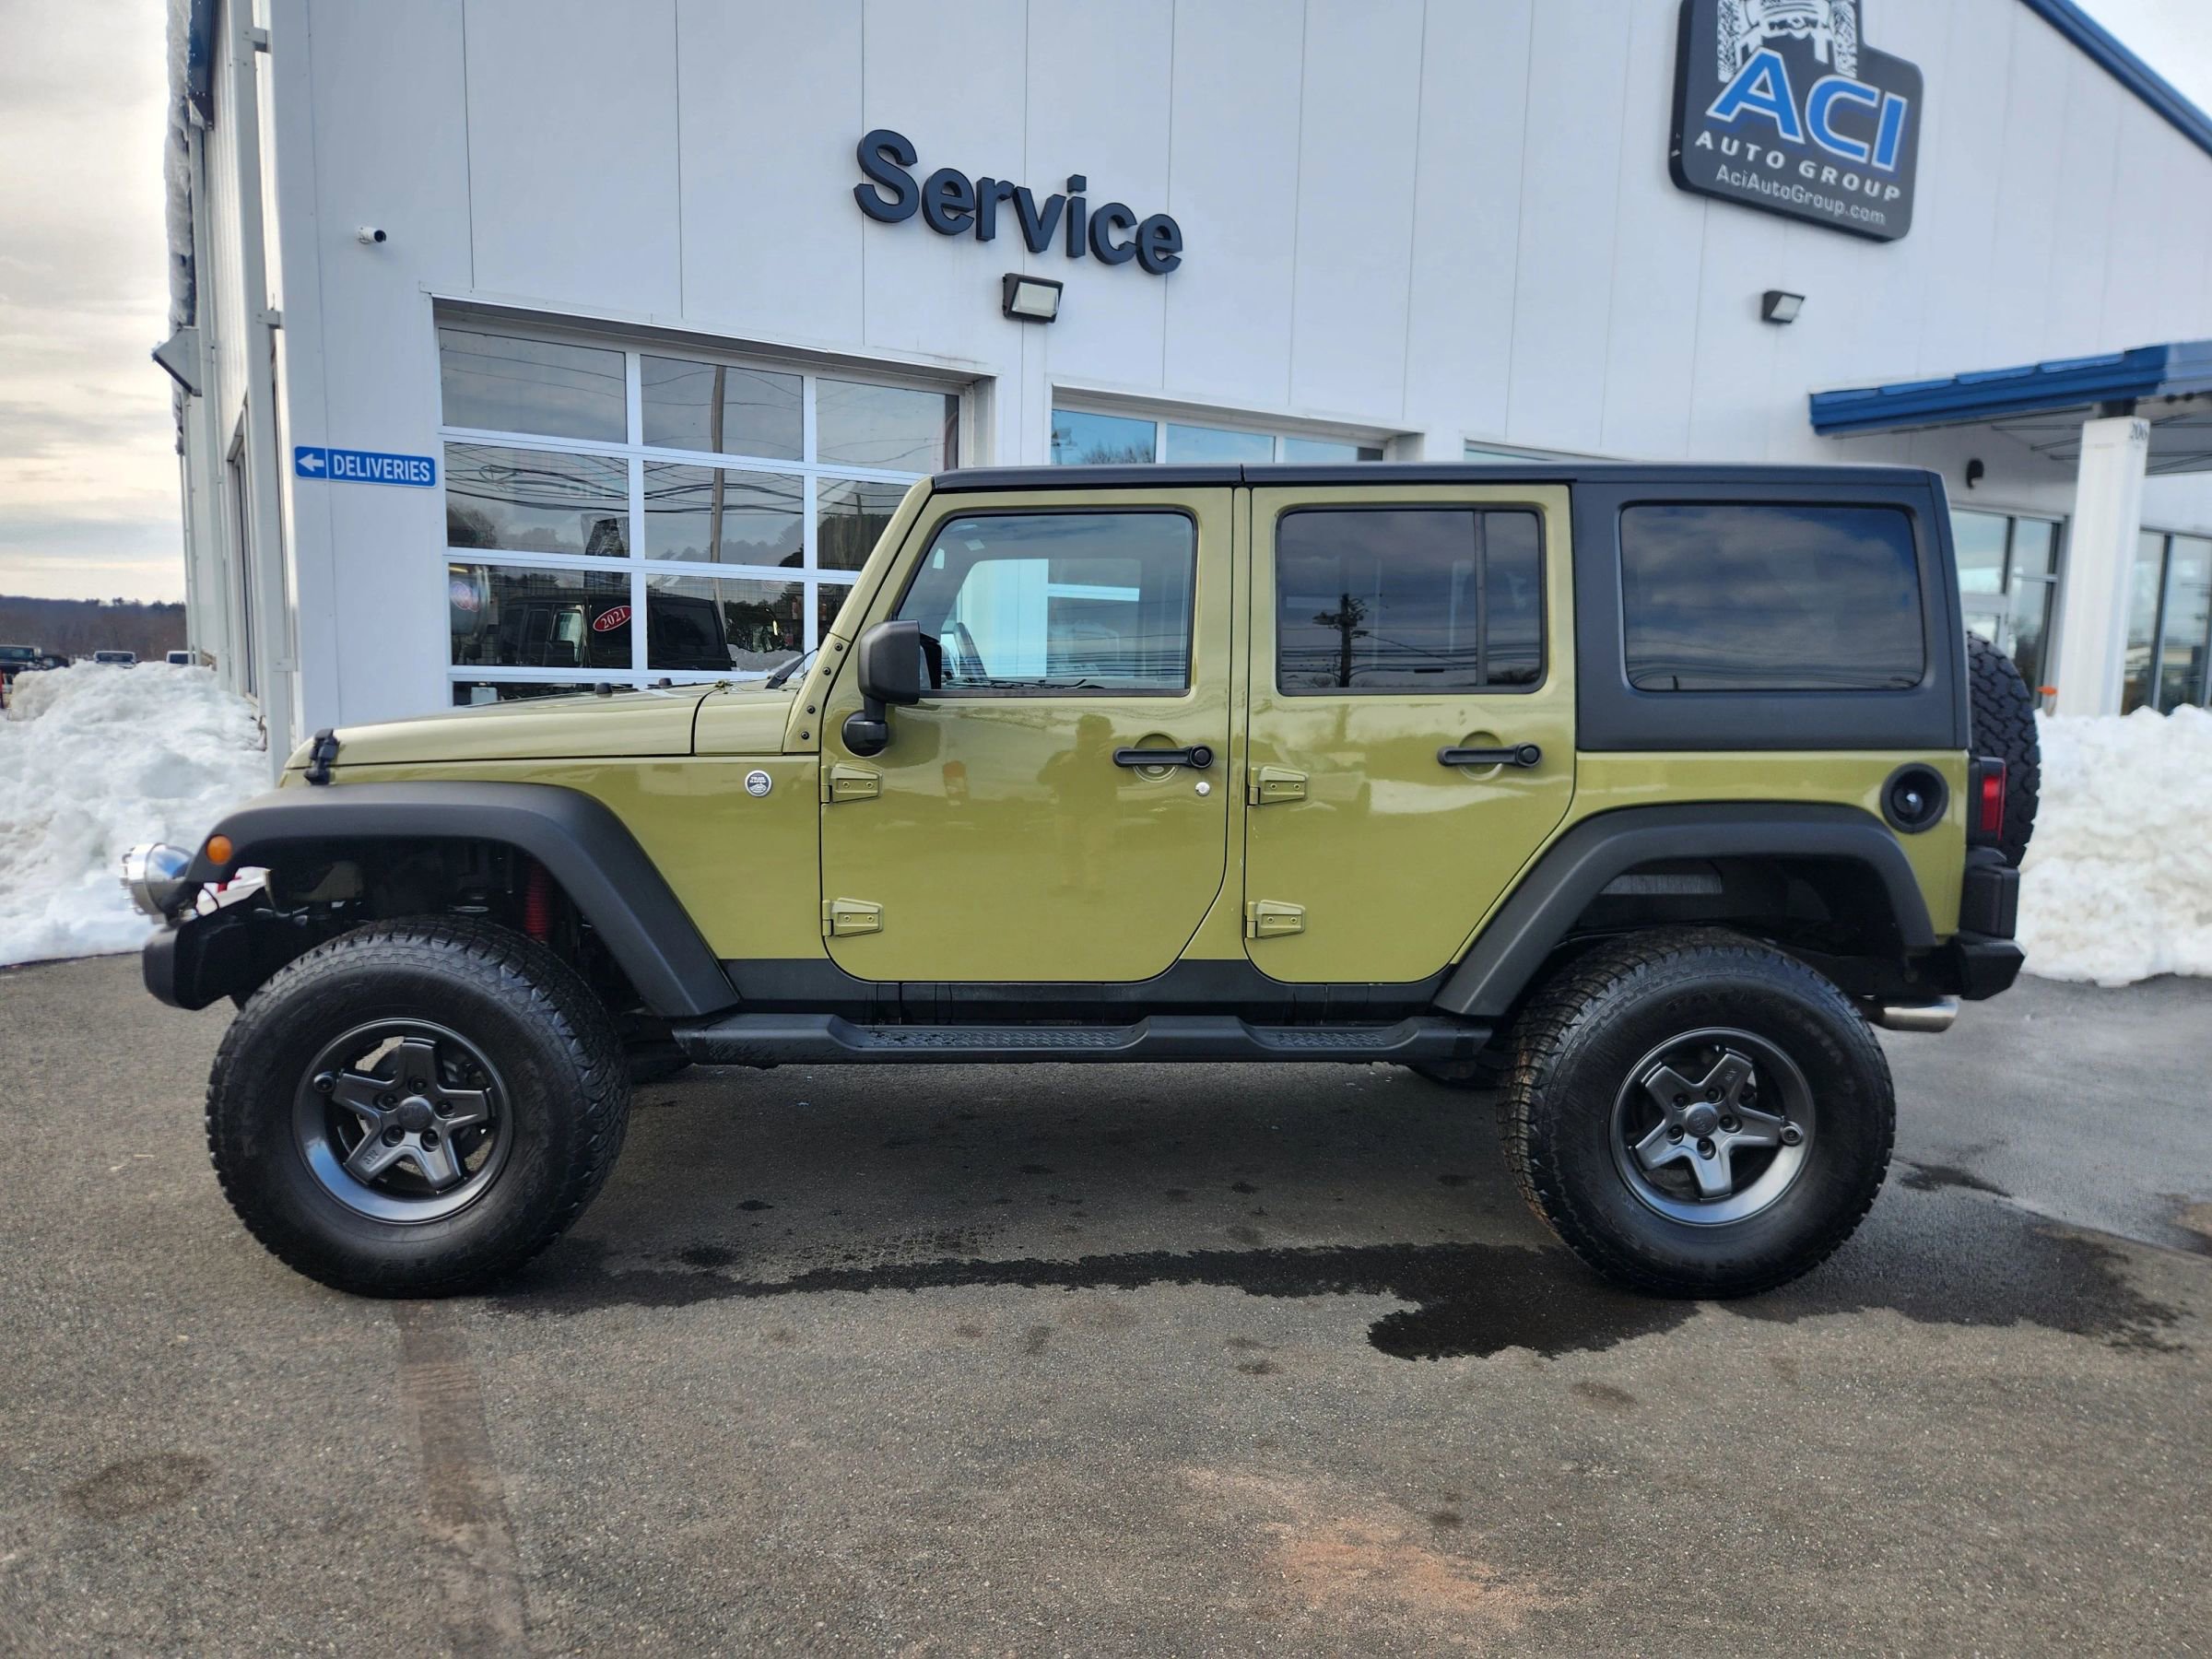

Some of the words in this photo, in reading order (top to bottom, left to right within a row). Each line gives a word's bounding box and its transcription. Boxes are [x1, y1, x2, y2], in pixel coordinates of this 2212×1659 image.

[1705, 46, 1908, 172] ACI
[1694, 130, 1786, 170] AUTO
[1798, 159, 1901, 202] GROUP
[1715, 164, 1887, 226] AciAutoGroup.com
[853, 129, 1183, 276] Service
[333, 453, 430, 482] DELIVERIES
[600, 607, 626, 629] 2021
